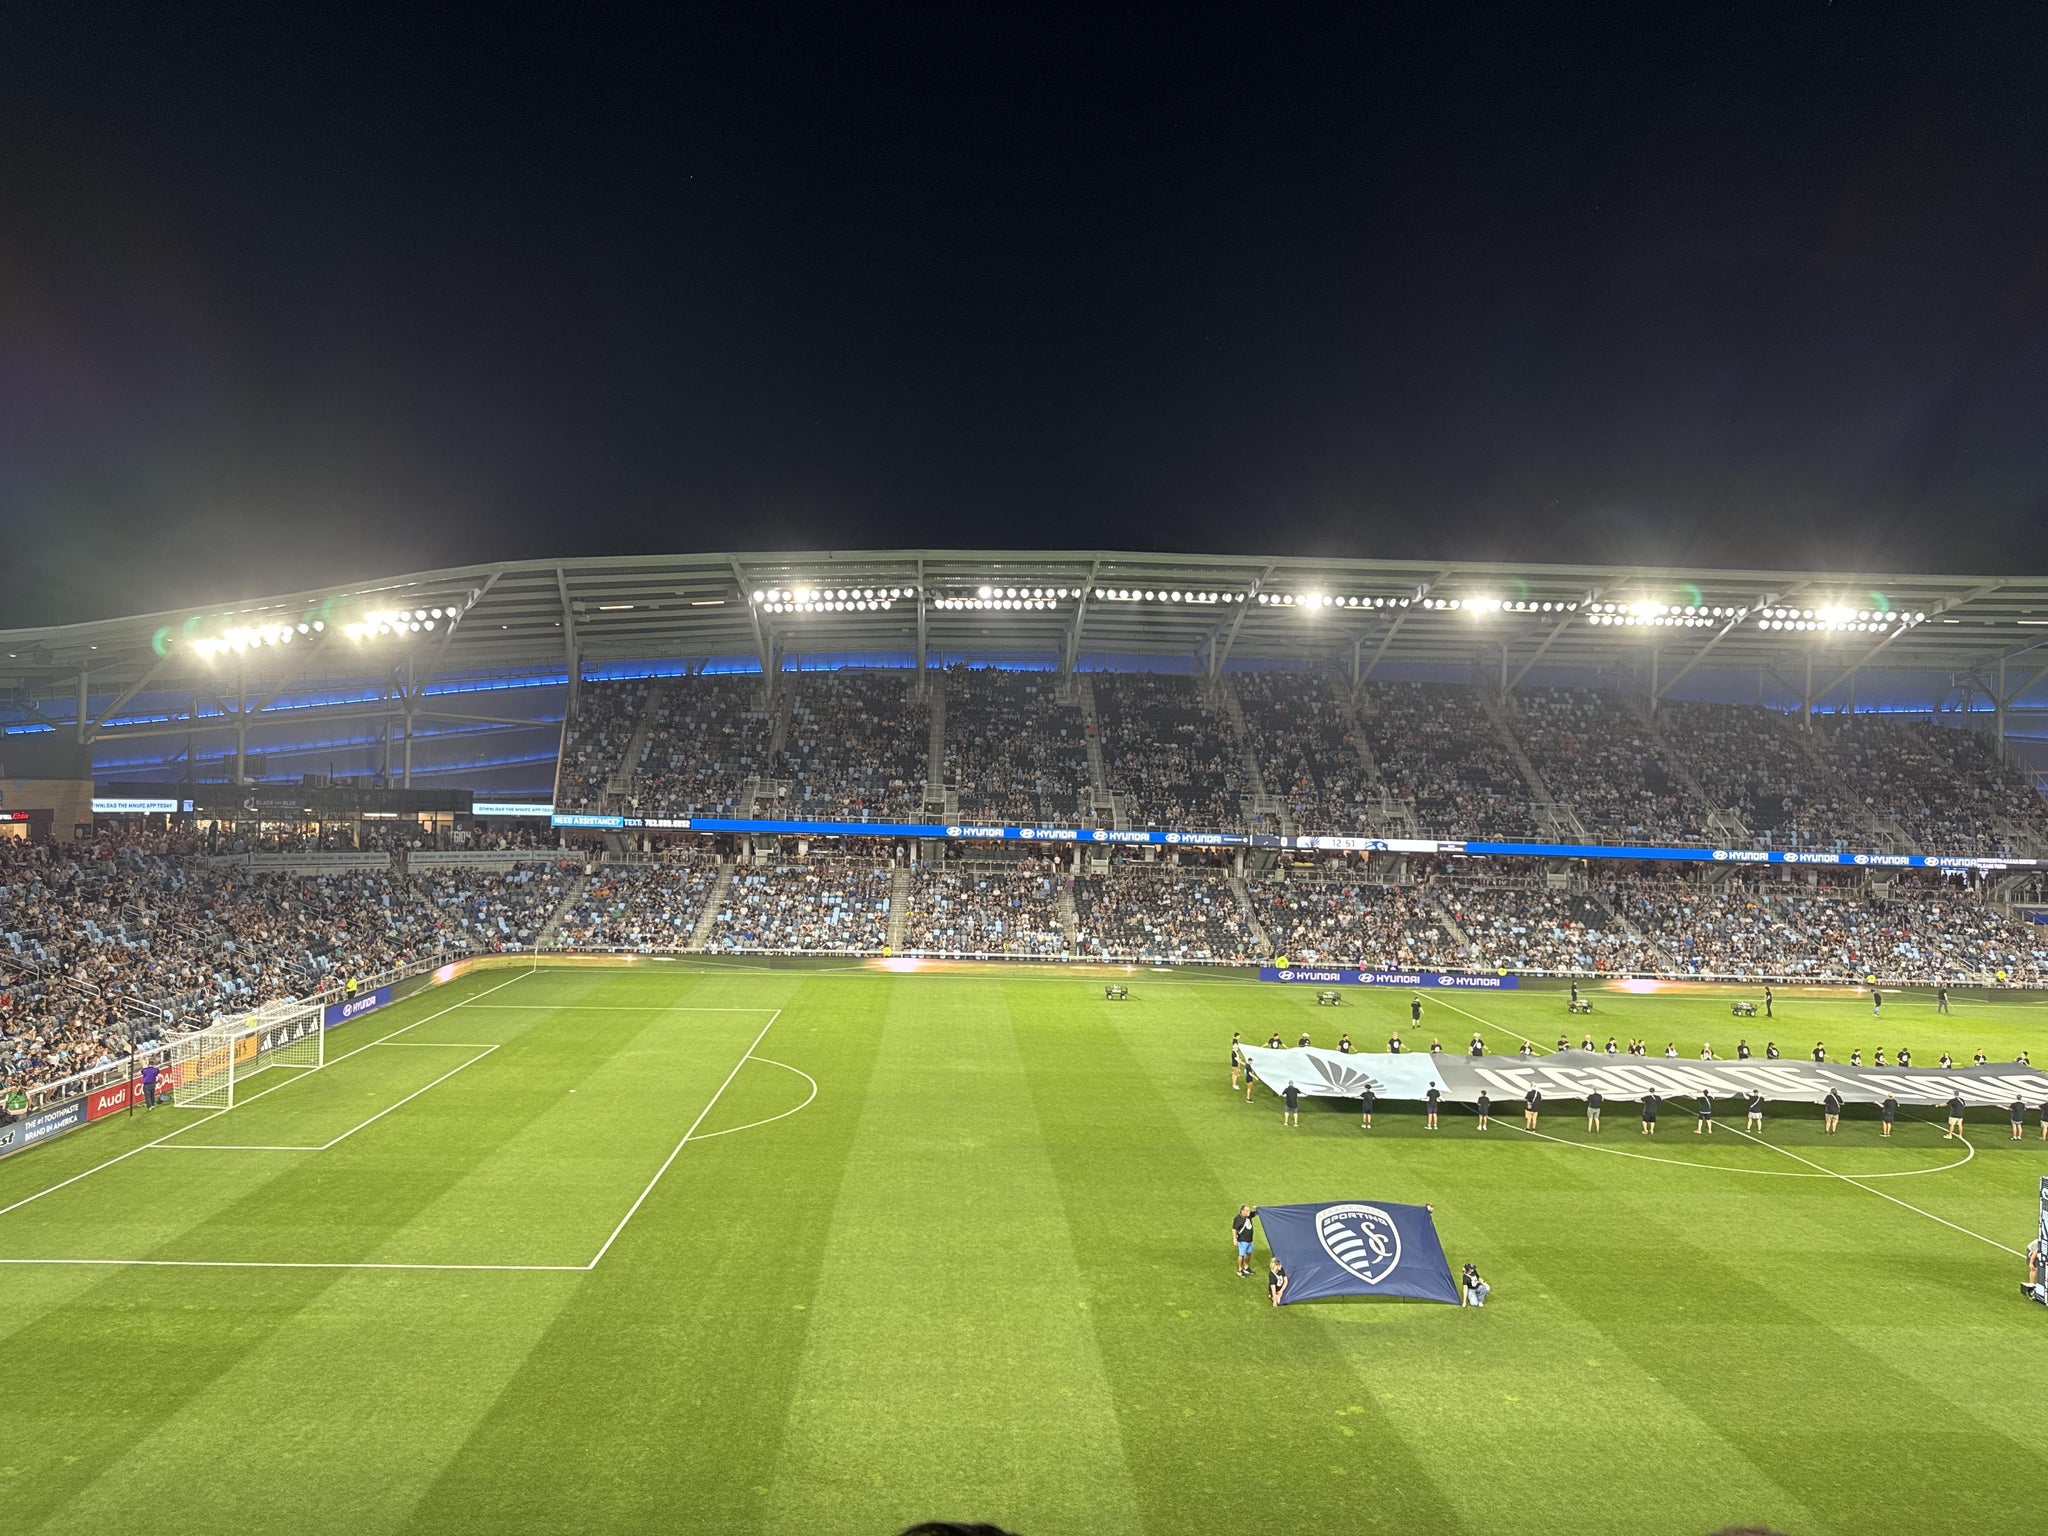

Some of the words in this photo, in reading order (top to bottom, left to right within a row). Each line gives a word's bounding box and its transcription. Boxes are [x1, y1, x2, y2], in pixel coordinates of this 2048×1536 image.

[574, 817, 620, 826] ASSISTANCE?
[624, 818, 643, 826] TEXT:
[963, 828, 1004, 837] HYUNDAI
[1036, 830, 1077, 839] HYUNDAI
[1109, 832, 1150, 841] HYUNDAI
[1182, 834, 1222, 843] HYUNDAI
[1729, 852, 1769, 861] HYUNDAI
[1800, 853, 1839, 862] HYUNDAI
[1869, 855, 1909, 865] HYUNDAI
[1296, 971, 1340, 981] HYUNDAI
[1376, 974, 1420, 984] HYUNDAI
[1456, 976, 1500, 986] HYUNDAI
[352, 995, 376, 1013] HYUNDAI
[1474, 1065, 1745, 1098] LEGION
[1715, 1066, 1840, 1093] OF
[97, 1088, 126, 1111] Audi
[25, 1120, 37, 1131] THE
[44, 1103, 79, 1124] TOOTHPASTE
[25, 1129, 45, 1142] BRAND
[46, 1125, 53, 1133] IN
[53, 1115, 78, 1131] AMERICA
[0, 1130, 15, 1148] st
[1323, 1212, 1388, 1227] SPORTING
